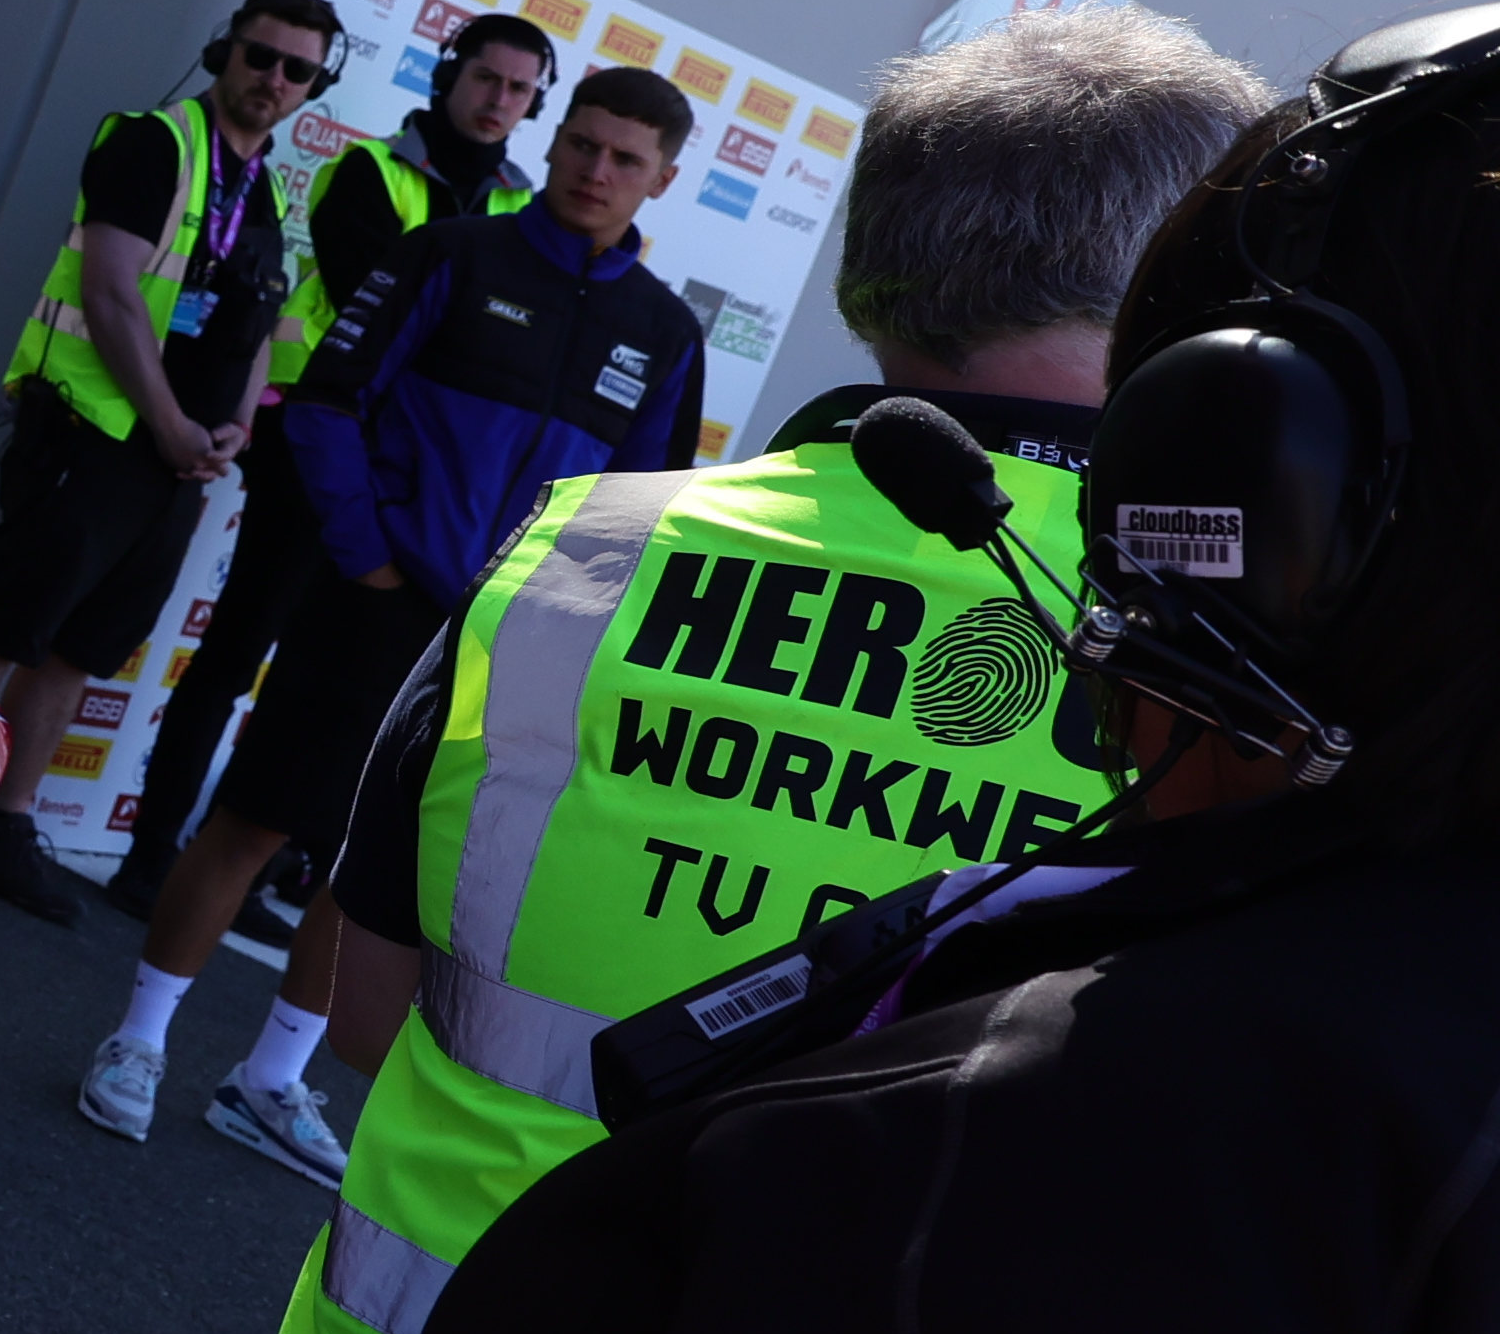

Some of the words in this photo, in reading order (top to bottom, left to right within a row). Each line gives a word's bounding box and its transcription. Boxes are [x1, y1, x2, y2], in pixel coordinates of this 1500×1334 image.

[1129, 507, 1241, 538] cloudbass
[81, 698, 123, 723] BSB
[611, 698, 1082, 865] WORKWE
[644, 837, 770, 937] TV
